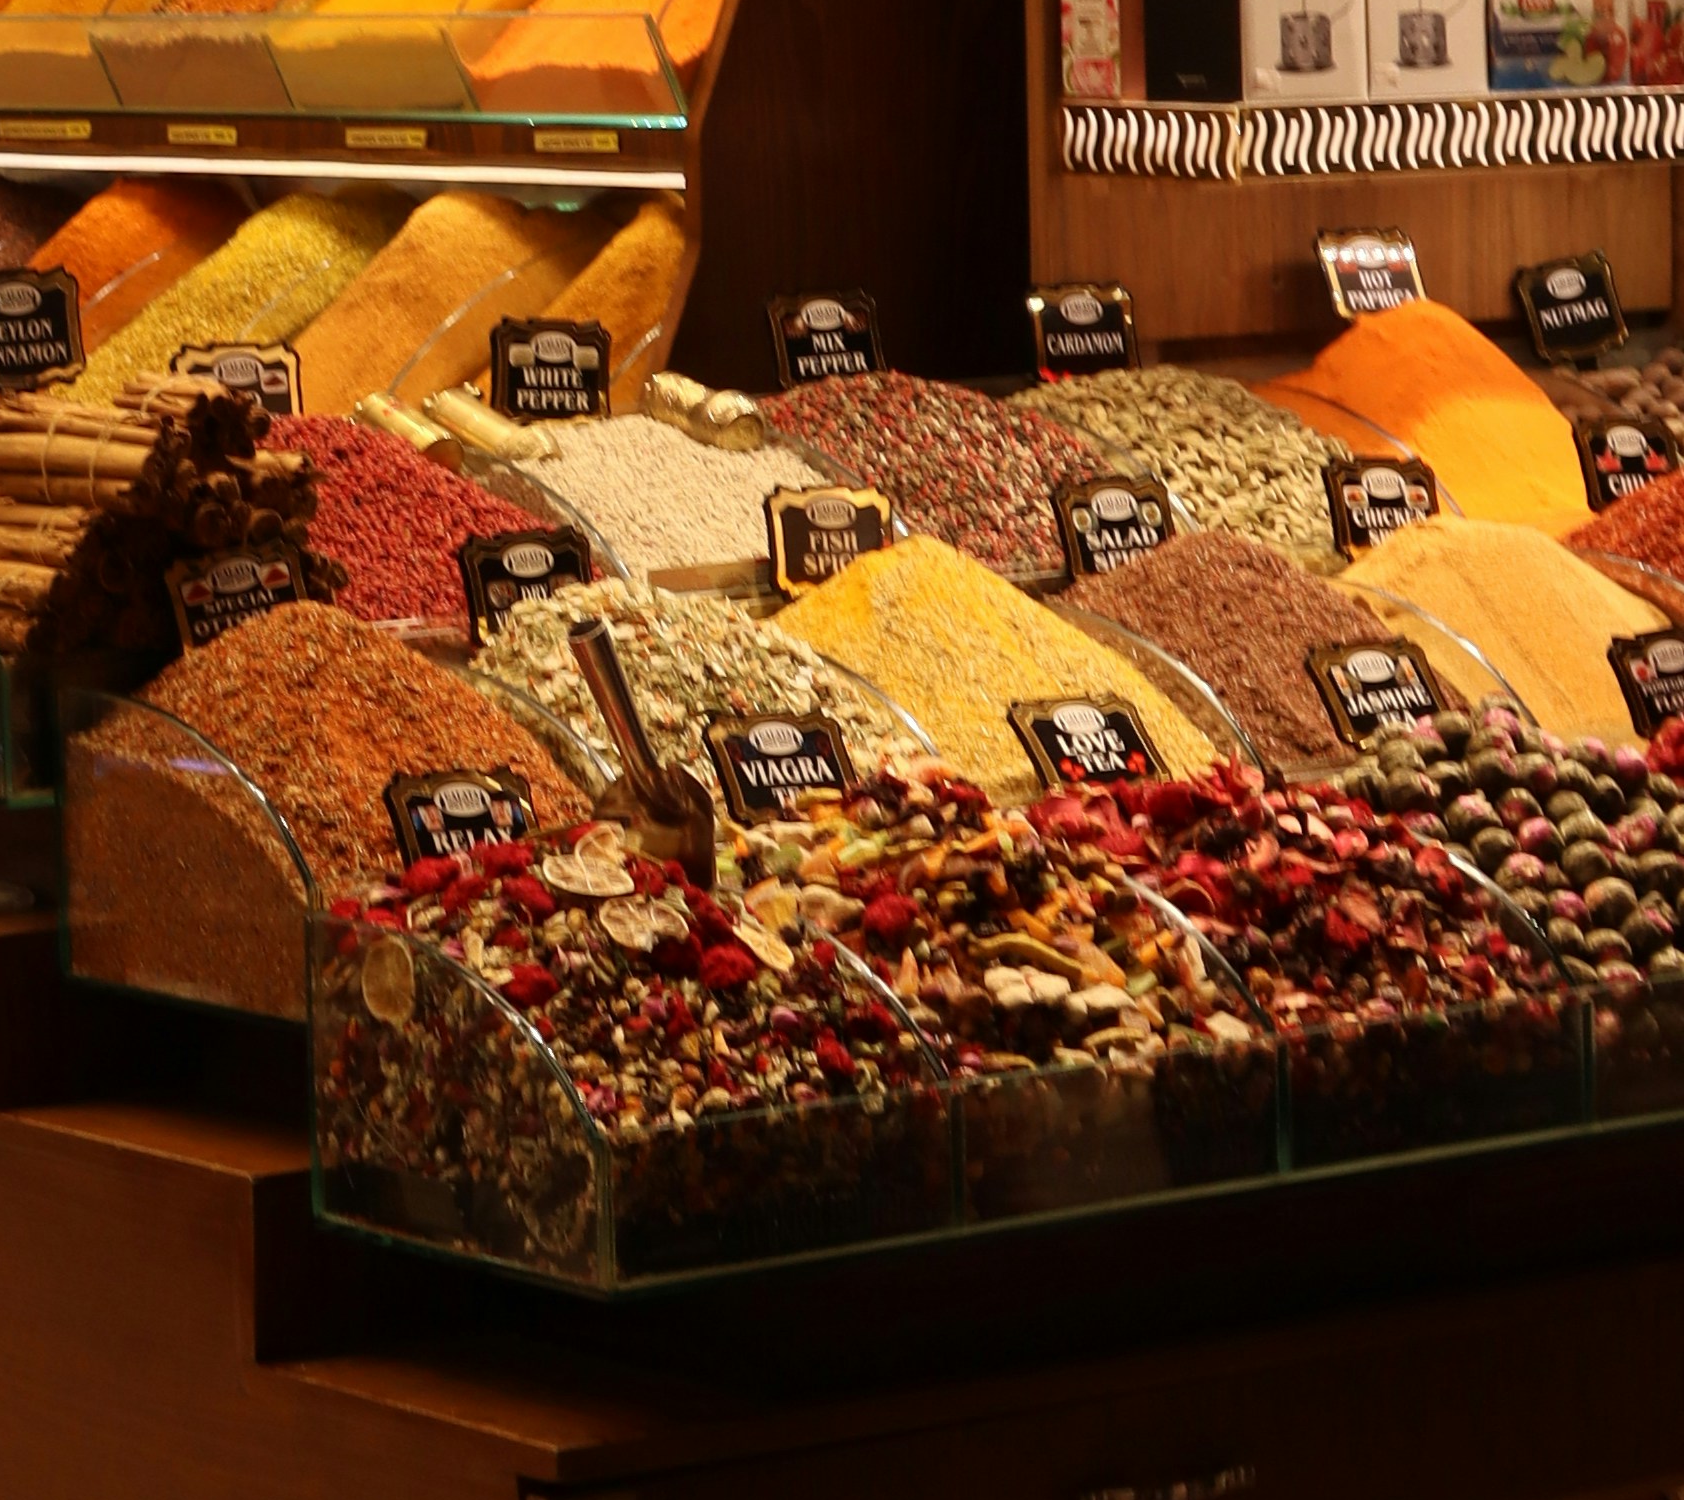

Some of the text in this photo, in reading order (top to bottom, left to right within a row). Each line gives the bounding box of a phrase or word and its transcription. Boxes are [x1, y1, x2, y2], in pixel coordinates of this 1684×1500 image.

[810, 331, 847, 353] MIX
[796, 350, 870, 377] PEPPER
[521, 366, 584, 388] WHITE
[516, 387, 591, 411] PEPPER
[807, 529, 859, 553] FISH
[1085, 525, 1159, 552] SALAD
[802, 551, 856, 577] SPIC
[1346, 684, 1433, 718] JASMINE
[1055, 727, 1127, 757] LOVE
[738, 754, 838, 788] VIAGRA
[1073, 750, 1129, 774] TEA
